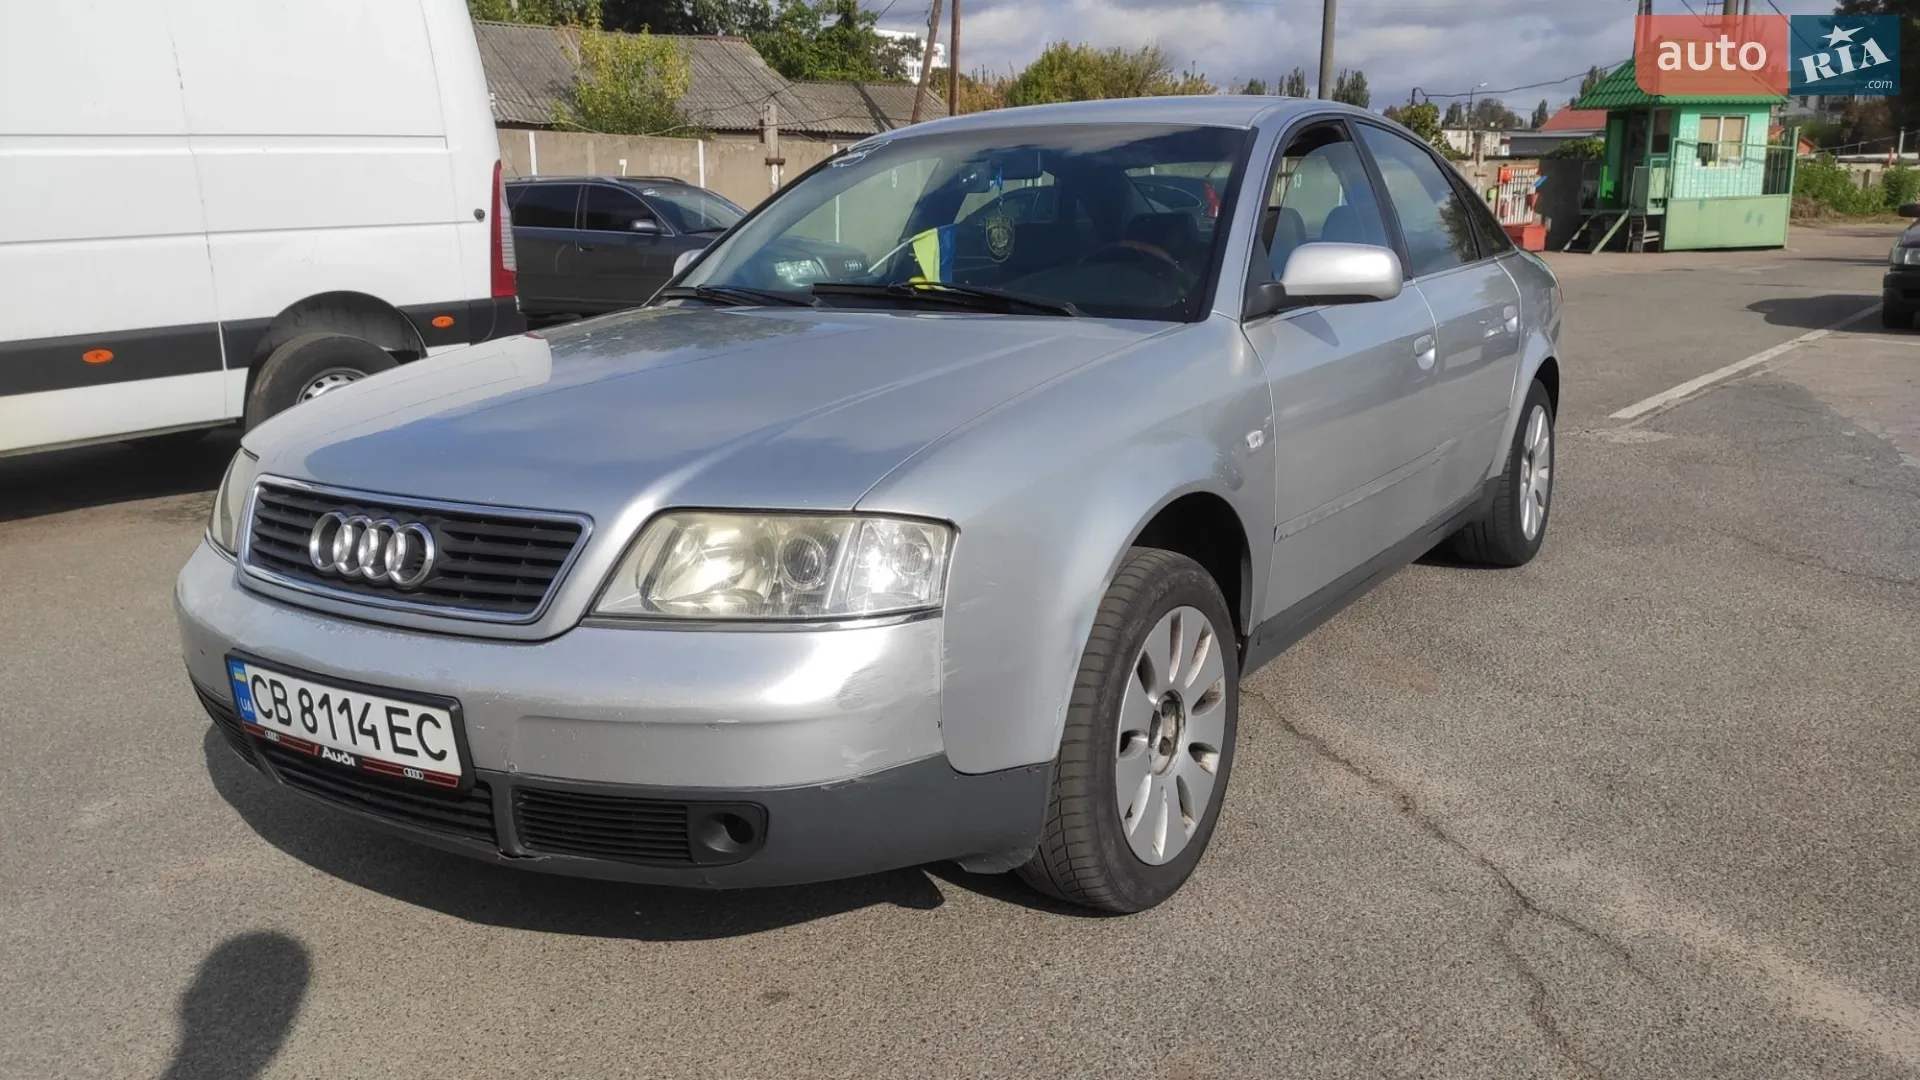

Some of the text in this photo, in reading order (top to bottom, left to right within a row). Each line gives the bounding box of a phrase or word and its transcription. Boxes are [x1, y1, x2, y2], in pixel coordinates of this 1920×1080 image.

[251, 674, 447, 761] CB 8114 EC
[321, 747, 356, 767] Audi
